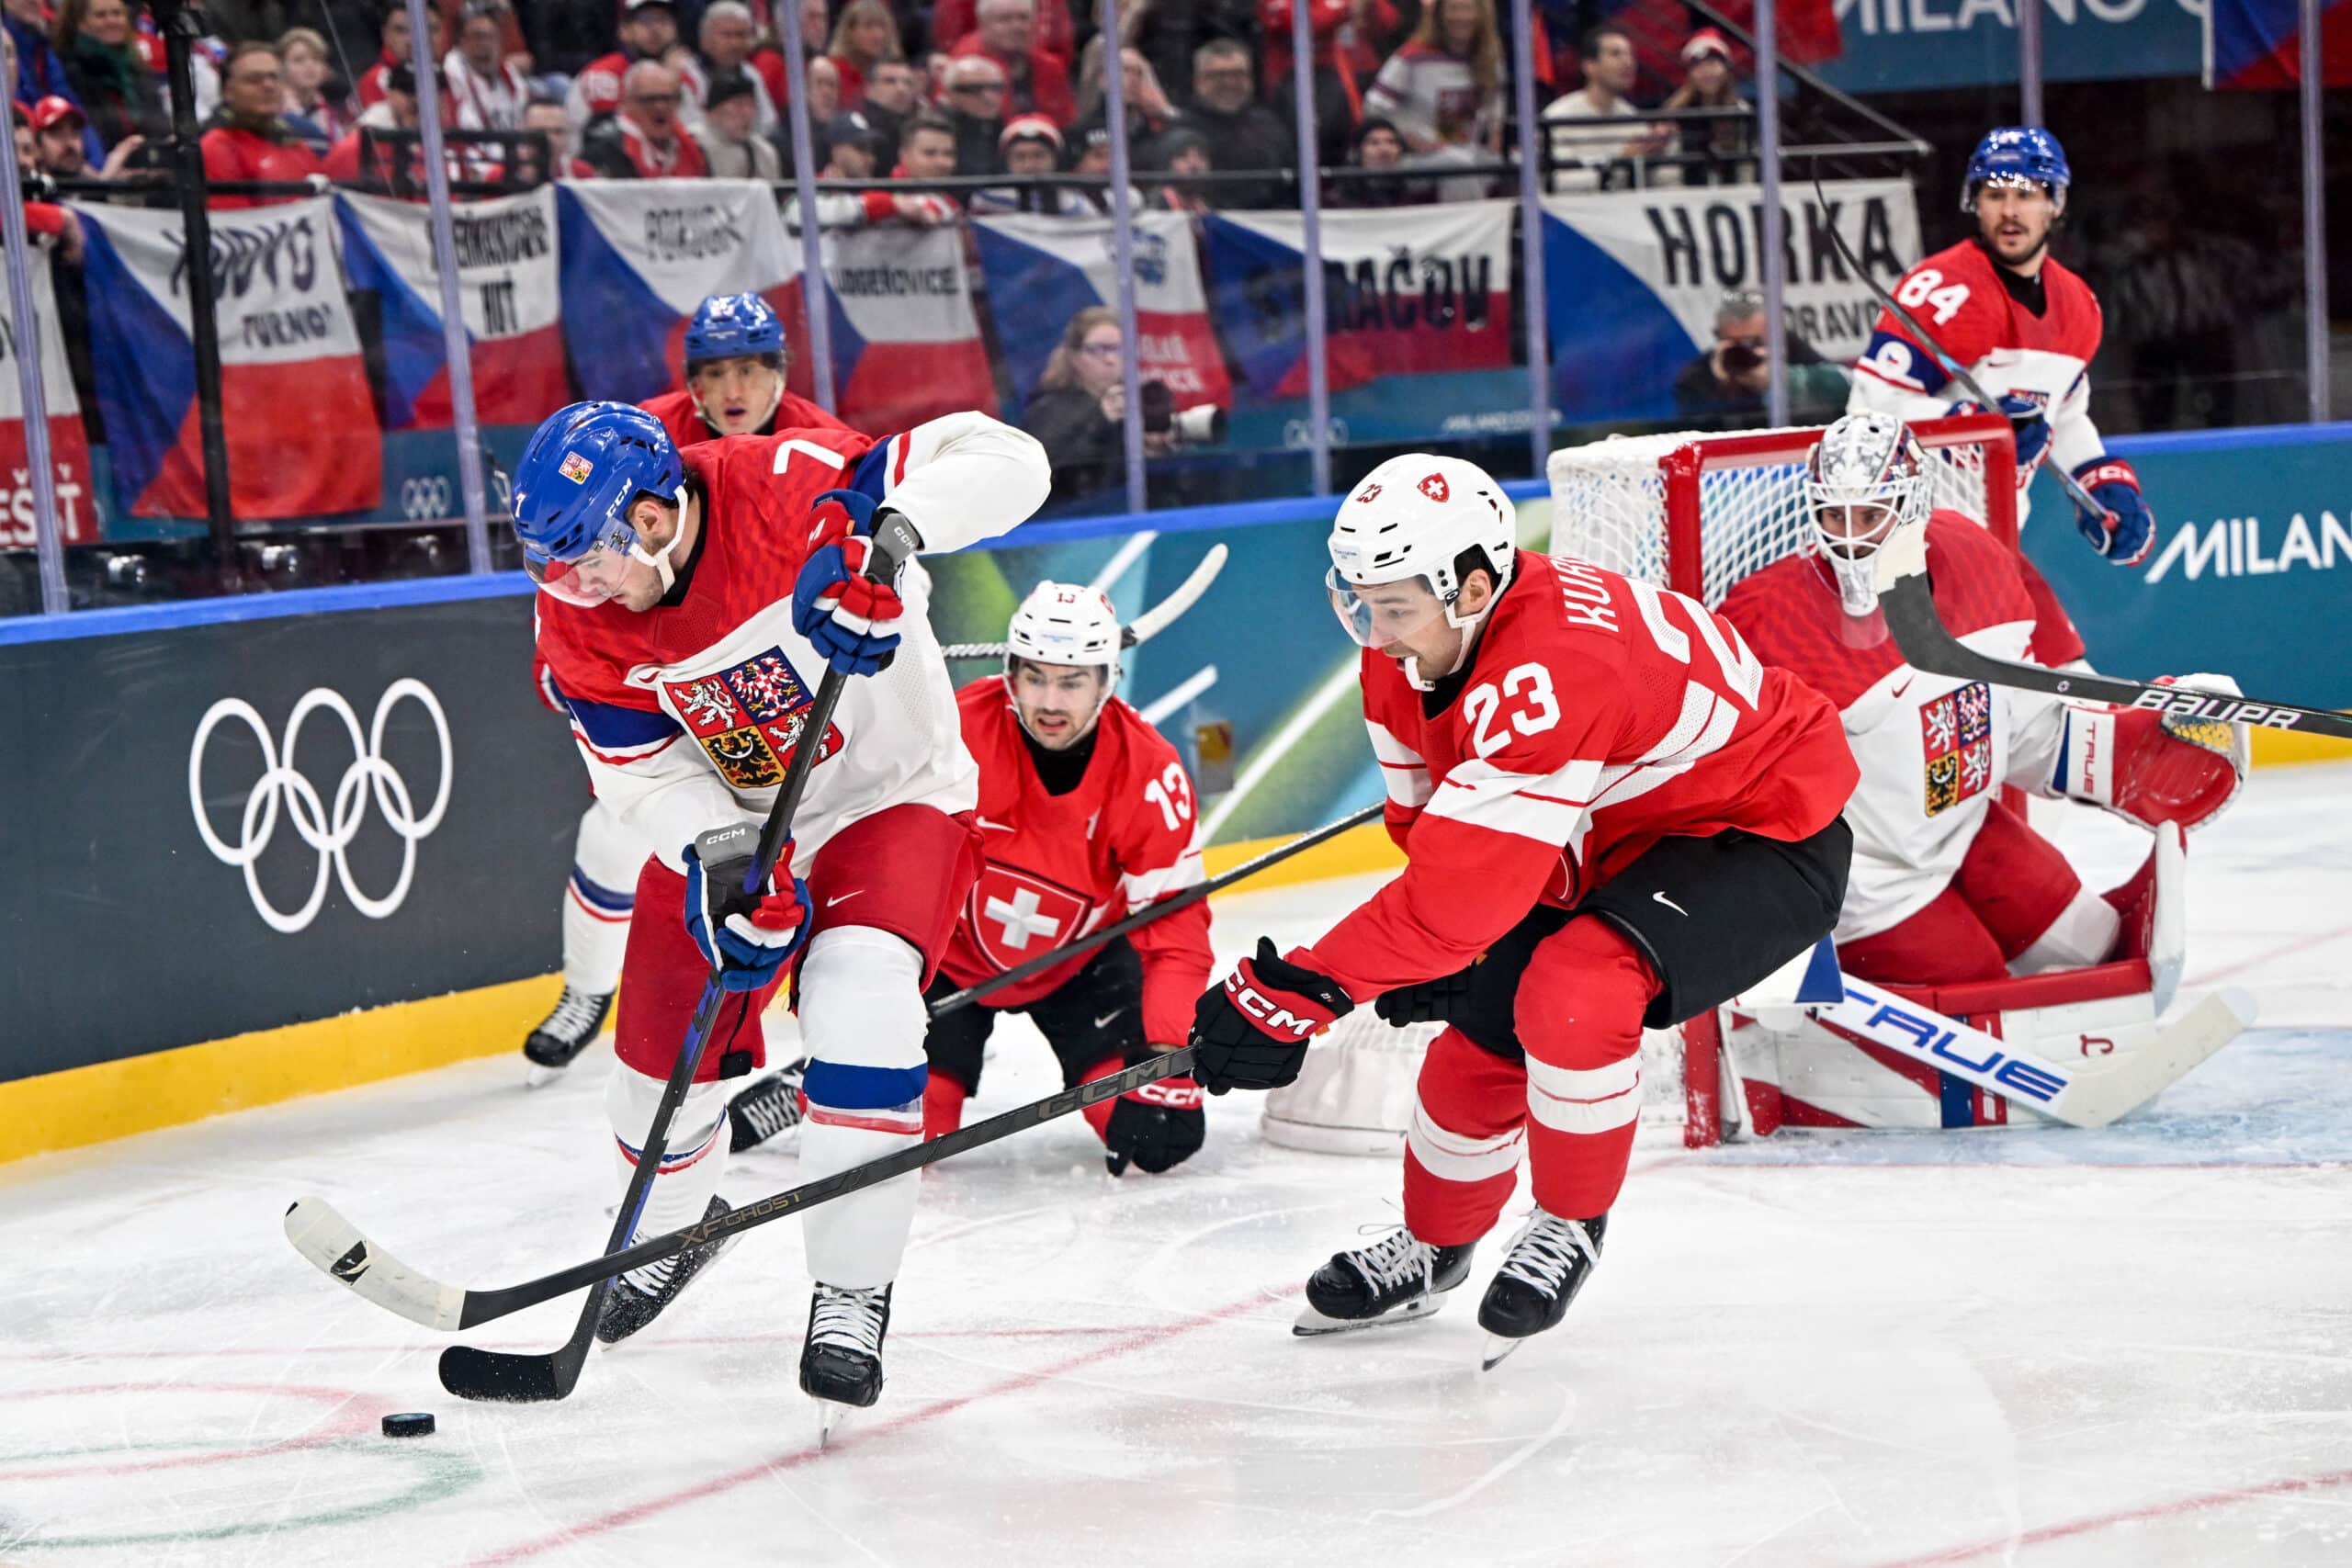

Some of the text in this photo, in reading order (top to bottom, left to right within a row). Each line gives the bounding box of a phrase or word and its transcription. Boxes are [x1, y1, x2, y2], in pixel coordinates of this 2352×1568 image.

[1645, 197, 1905, 288] HORKA
[1898, 269, 1971, 325] 84
[514, 491, 527, 519] 7
[605, 477, 633, 518] CCM
[1355, 483, 1383, 503] 23
[1463, 660, 1561, 760] 23
[2132, 689, 2303, 731] BAUER
[2083, 720, 2098, 795] TRUE
[1144, 761, 1193, 832] 13
[706, 827, 747, 846] CCM
[1224, 964, 1317, 1037] CCM
[1038, 1056, 1171, 1120] CCM
